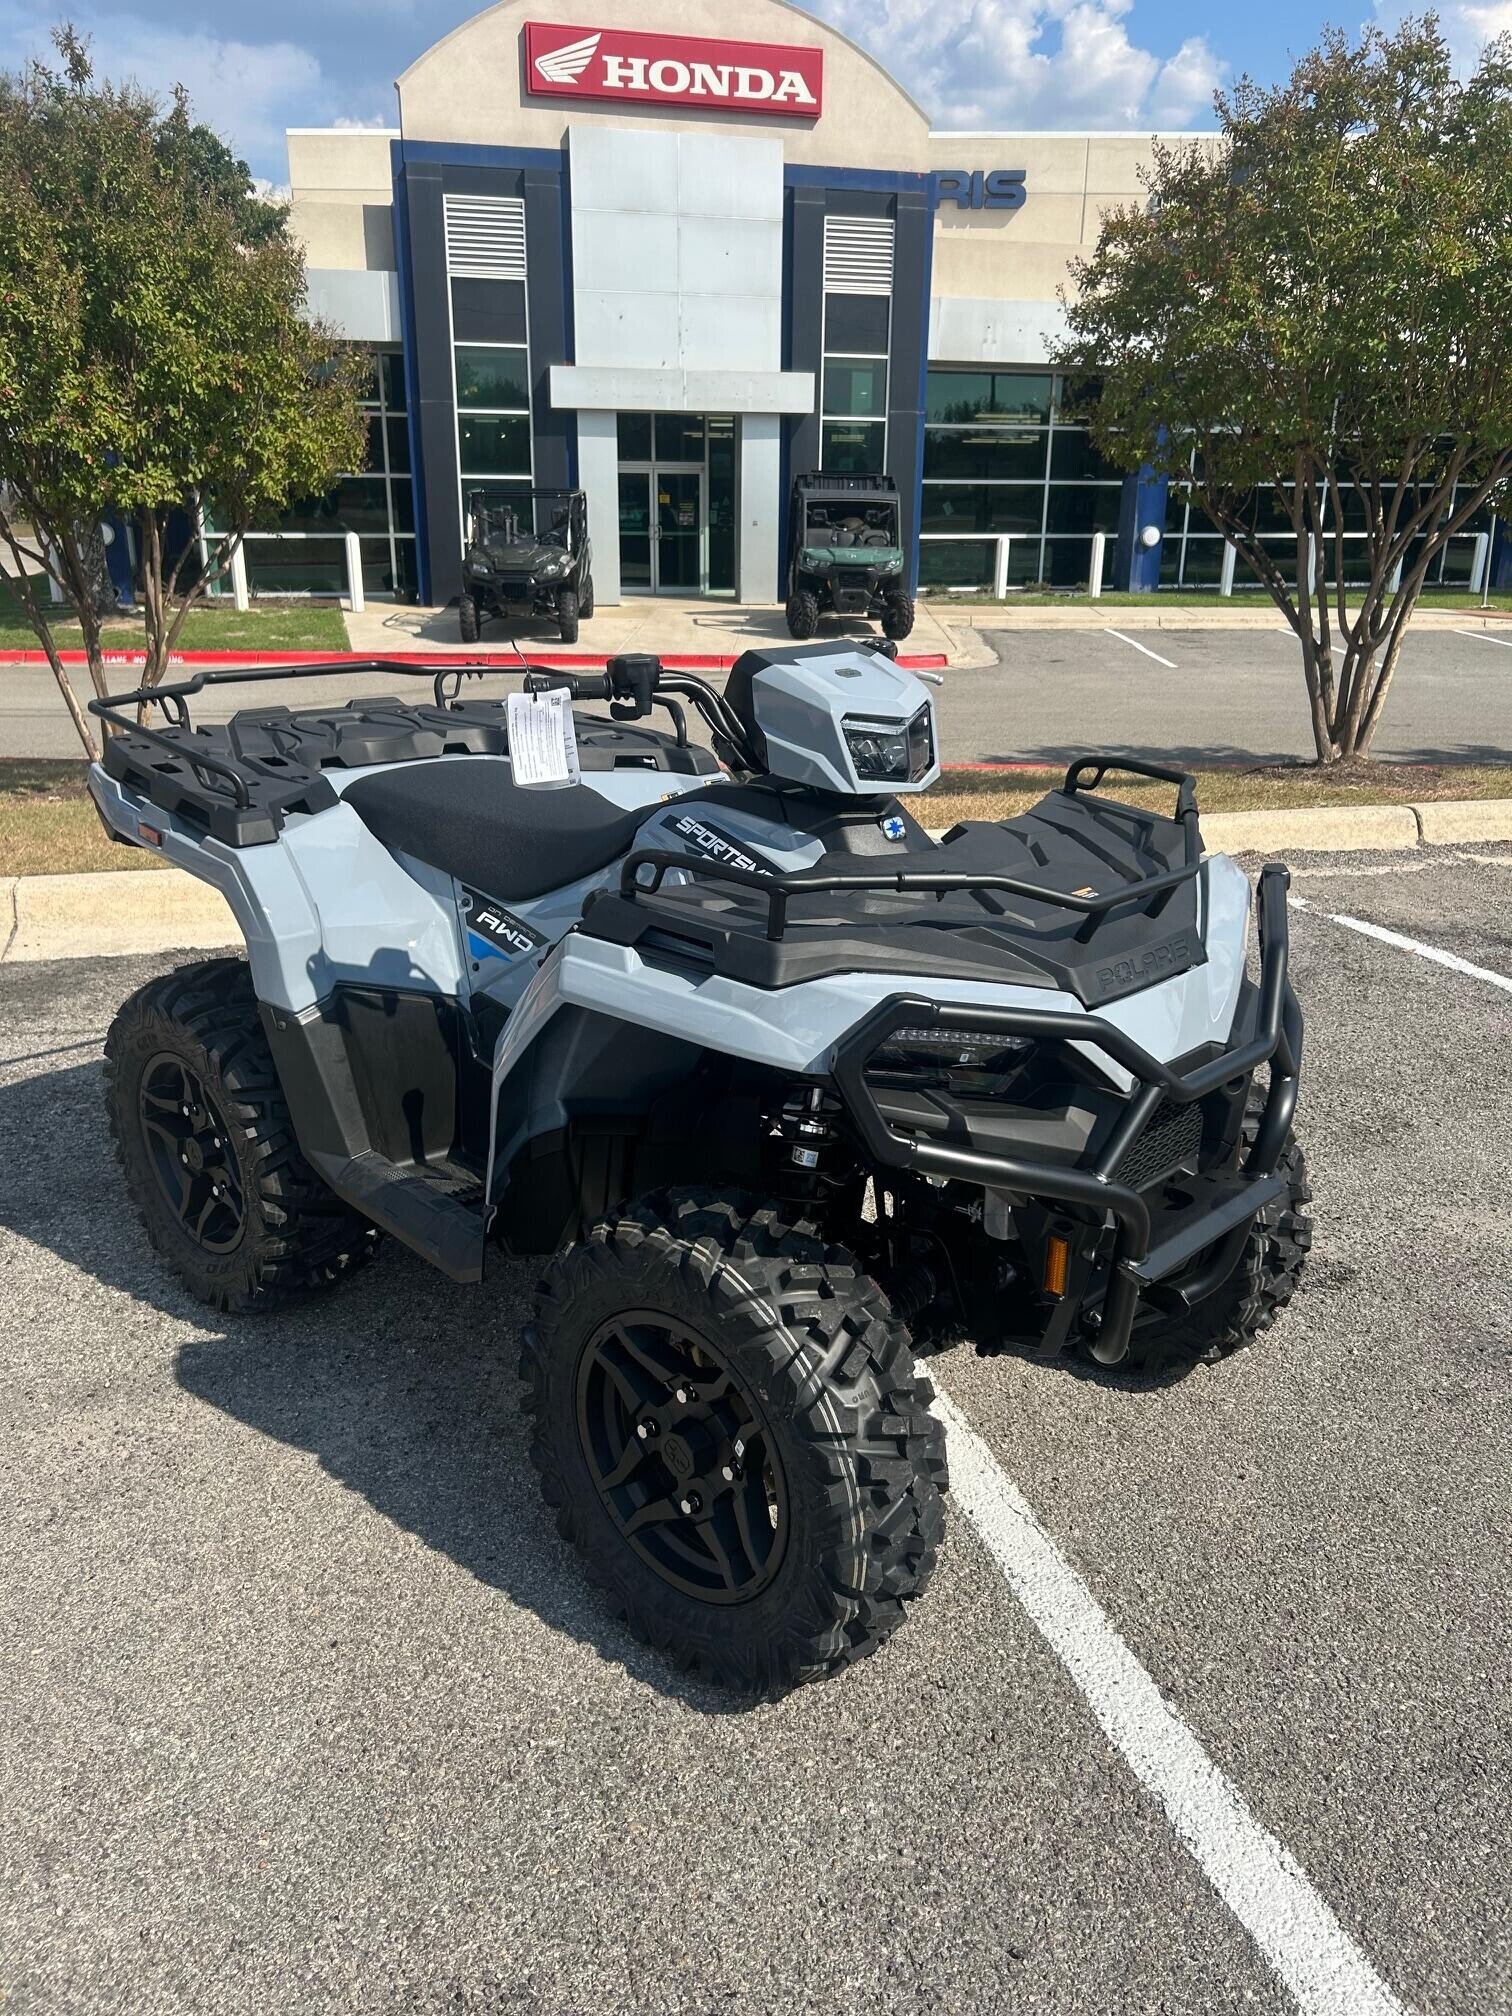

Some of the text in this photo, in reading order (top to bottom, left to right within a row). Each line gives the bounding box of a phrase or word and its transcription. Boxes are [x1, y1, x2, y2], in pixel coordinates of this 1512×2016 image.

[602, 55, 816, 104] HONDA
[676, 815, 774, 876] SPORTSM
[476, 911, 534, 952] AWD
[1096, 938, 1190, 992] POLARIS
